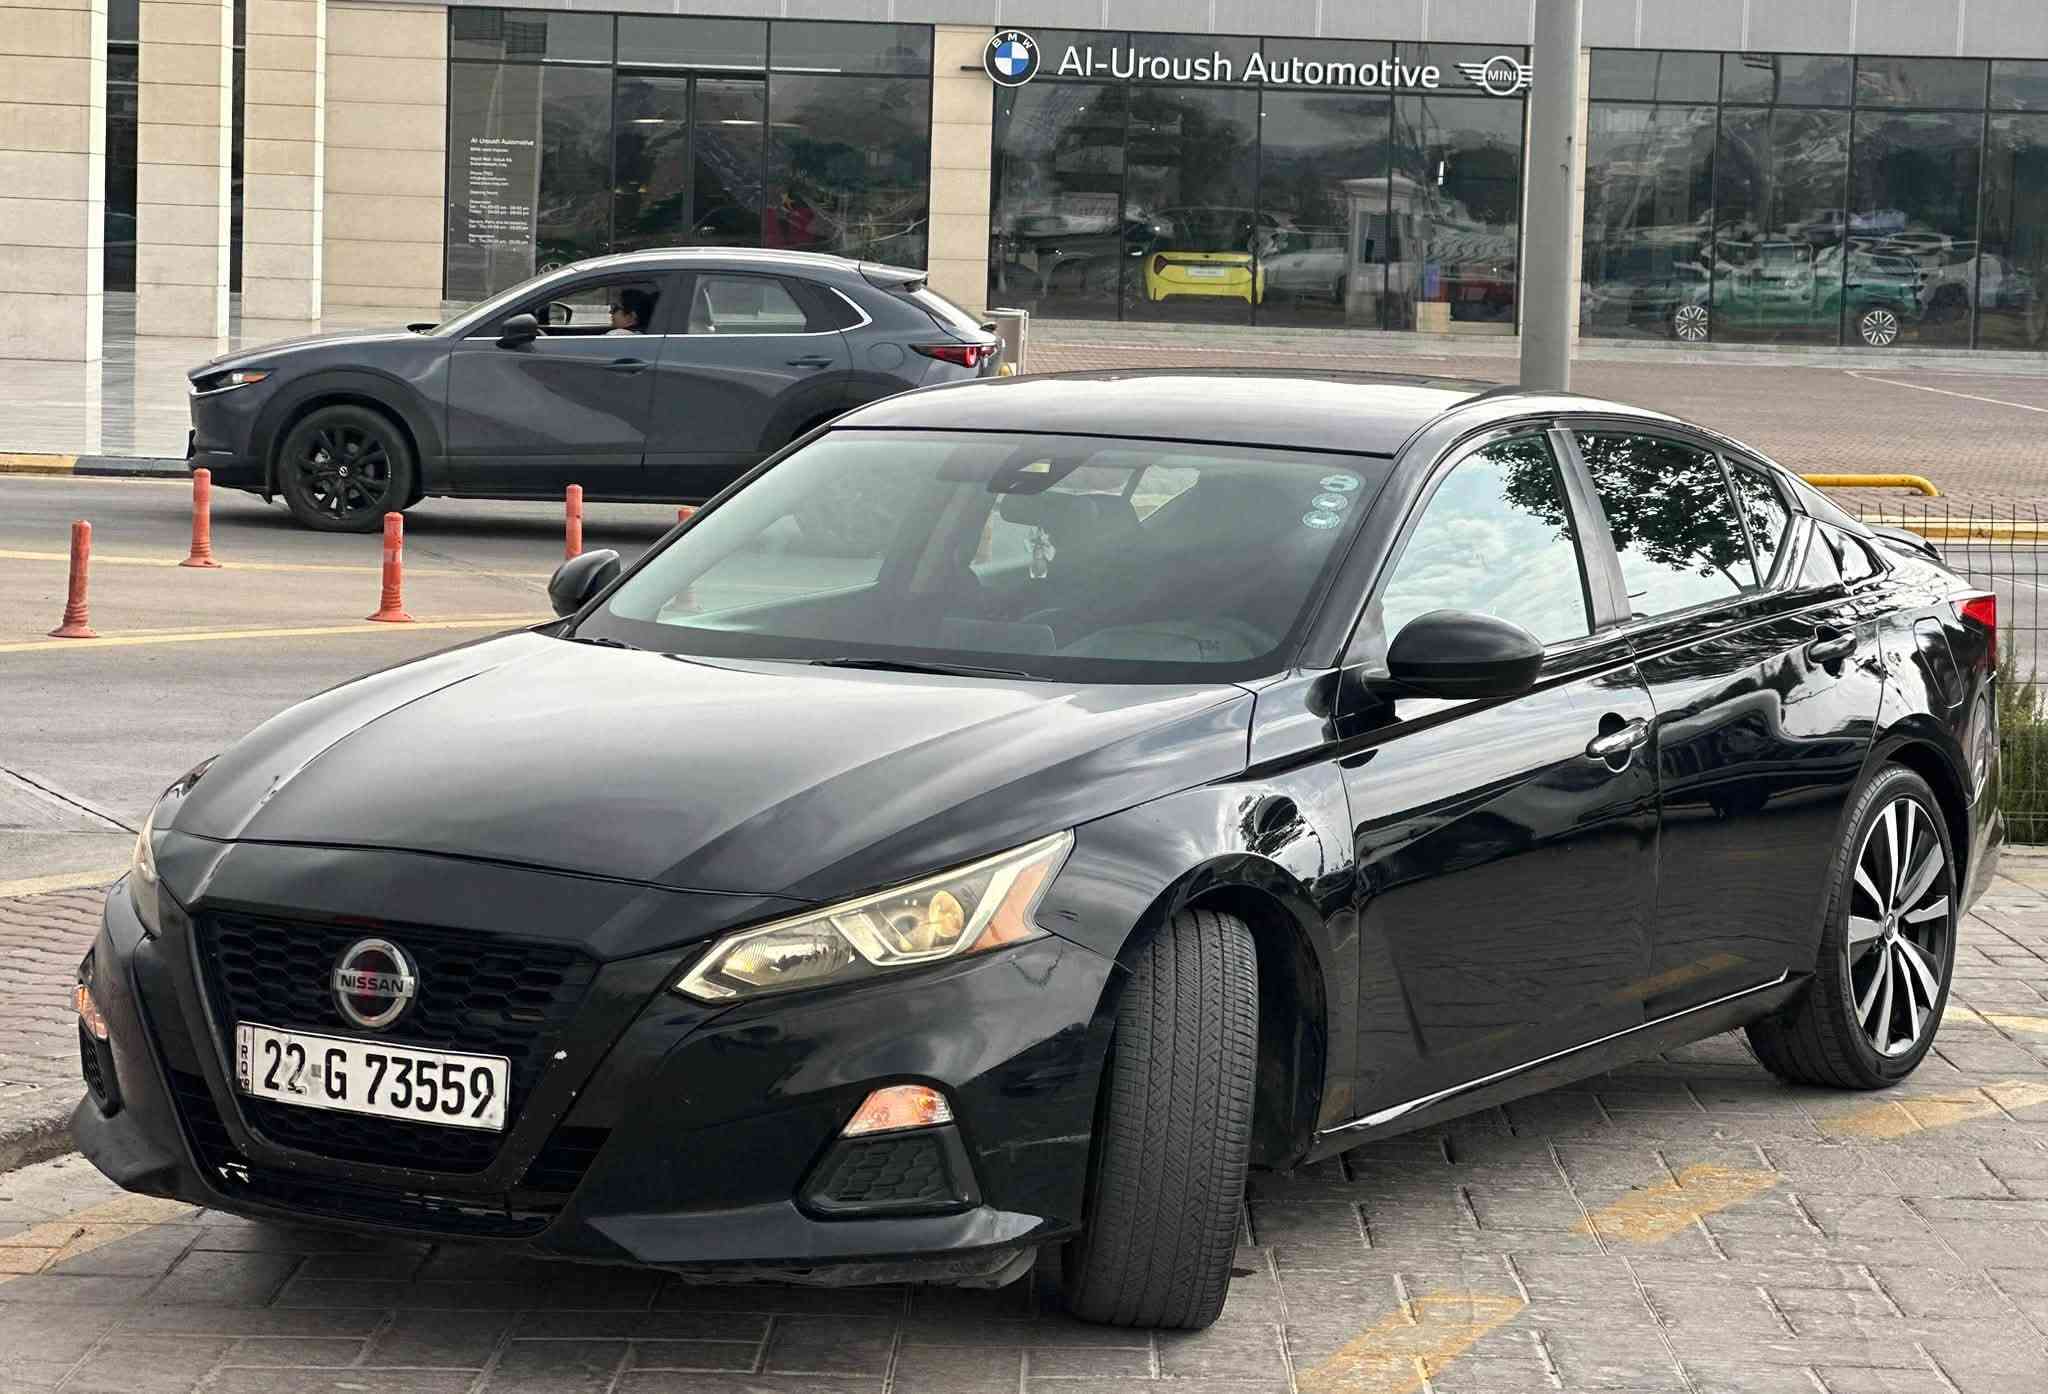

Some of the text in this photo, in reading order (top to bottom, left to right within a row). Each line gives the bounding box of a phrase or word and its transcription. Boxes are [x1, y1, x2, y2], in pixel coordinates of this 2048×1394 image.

[1058, 45, 1441, 88] Al-Uroush Automotive
[1487, 69, 1517, 81] MINI
[341, 974, 404, 993] NISSAN
[264, 1038, 495, 1118] 22 G 73559
